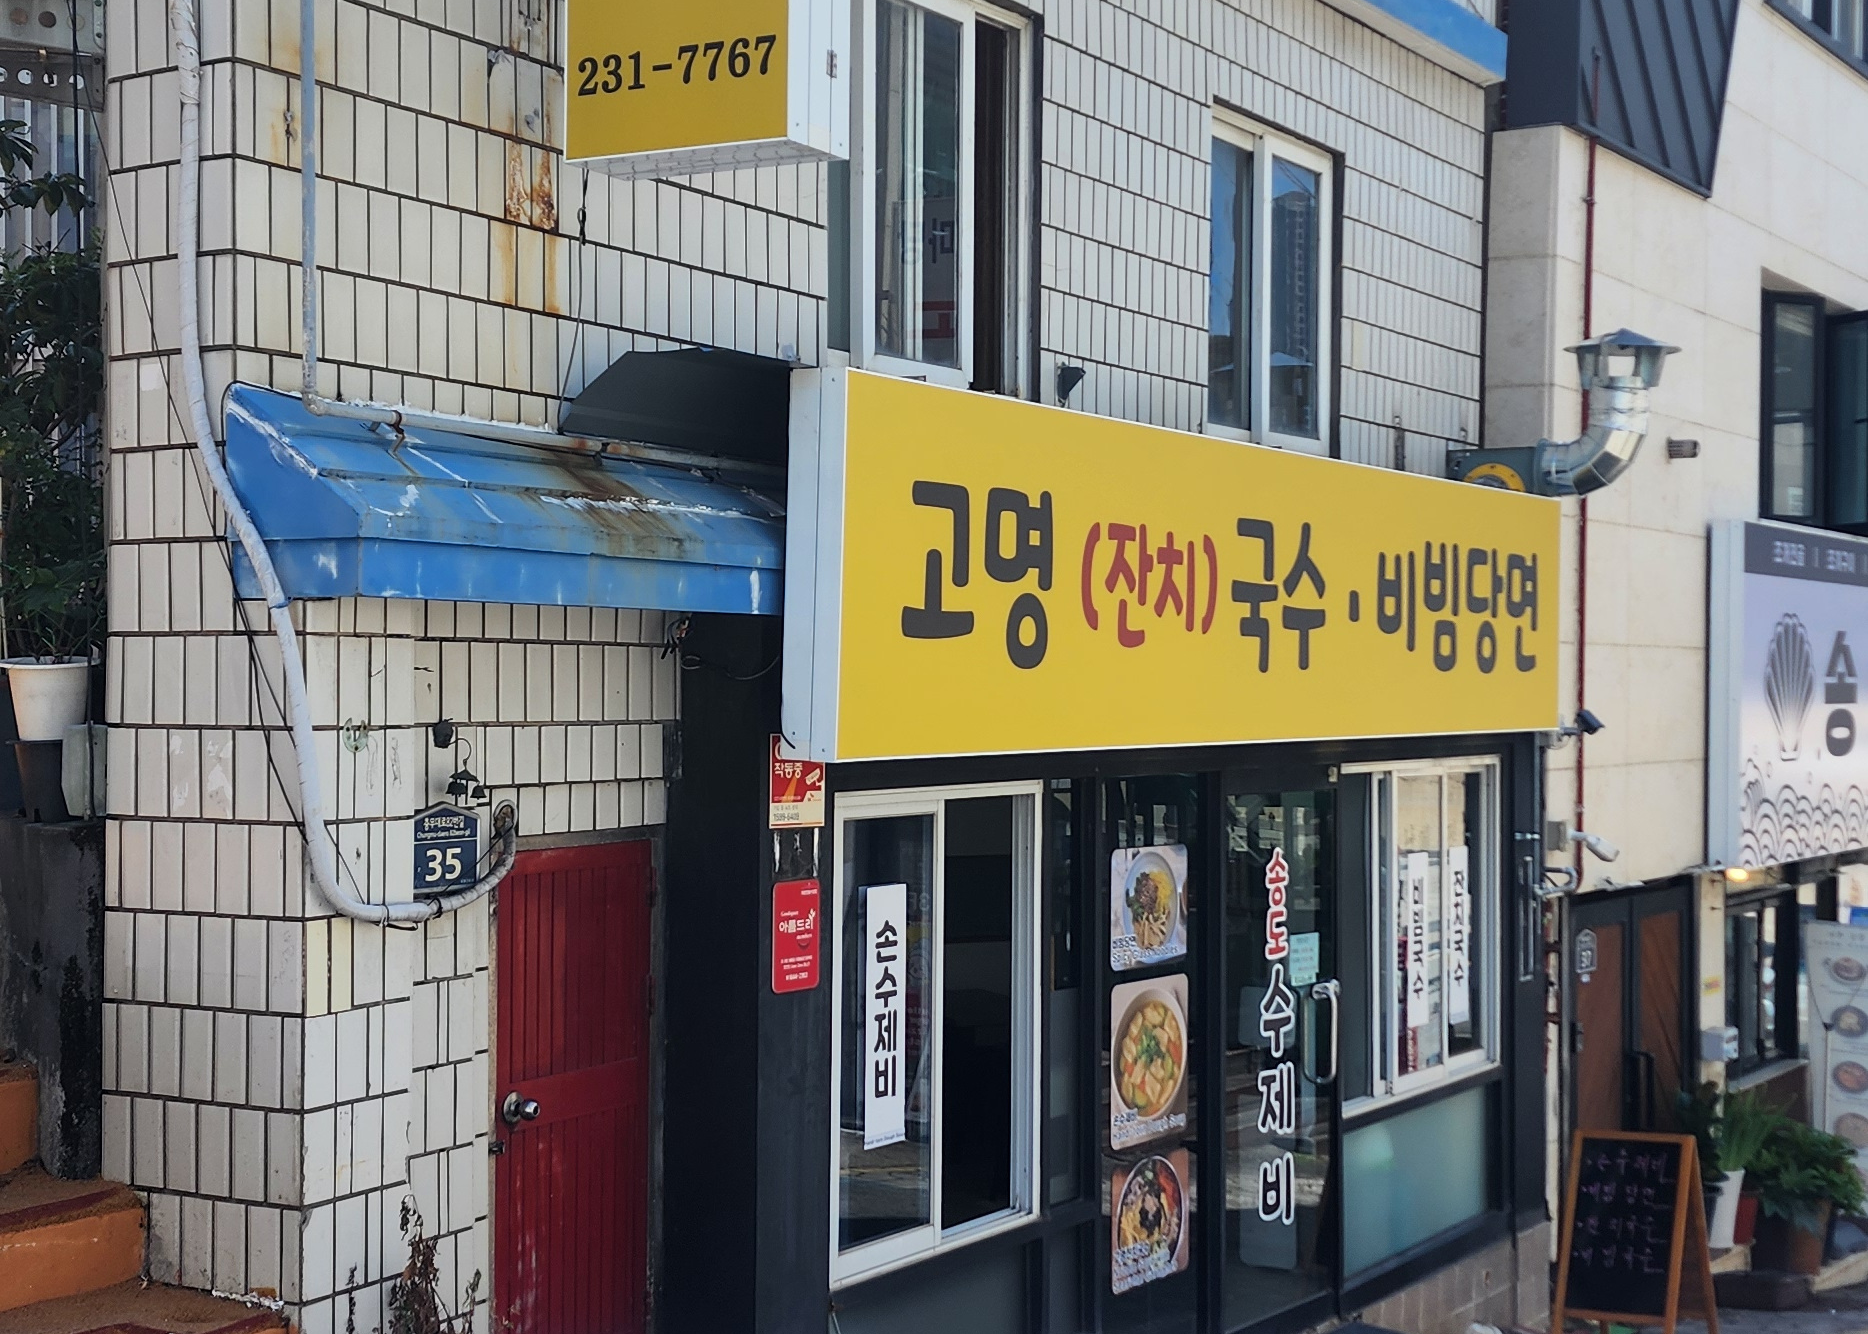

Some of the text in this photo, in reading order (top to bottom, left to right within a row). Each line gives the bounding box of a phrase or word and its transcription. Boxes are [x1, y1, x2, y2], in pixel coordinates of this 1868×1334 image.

[577, 34, 778, 98] 231-7767
[901, 479, 1054, 670] 고명
[1377, 540, 1538, 675] 비빔당면
[774, 762, 803, 778] 작동중
[425, 847, 462, 882] 35
[779, 911, 816, 933] 아름드리
[873, 919, 898, 1098] 손수제비
[1257, 847, 1295, 1225] 송도 수제비
